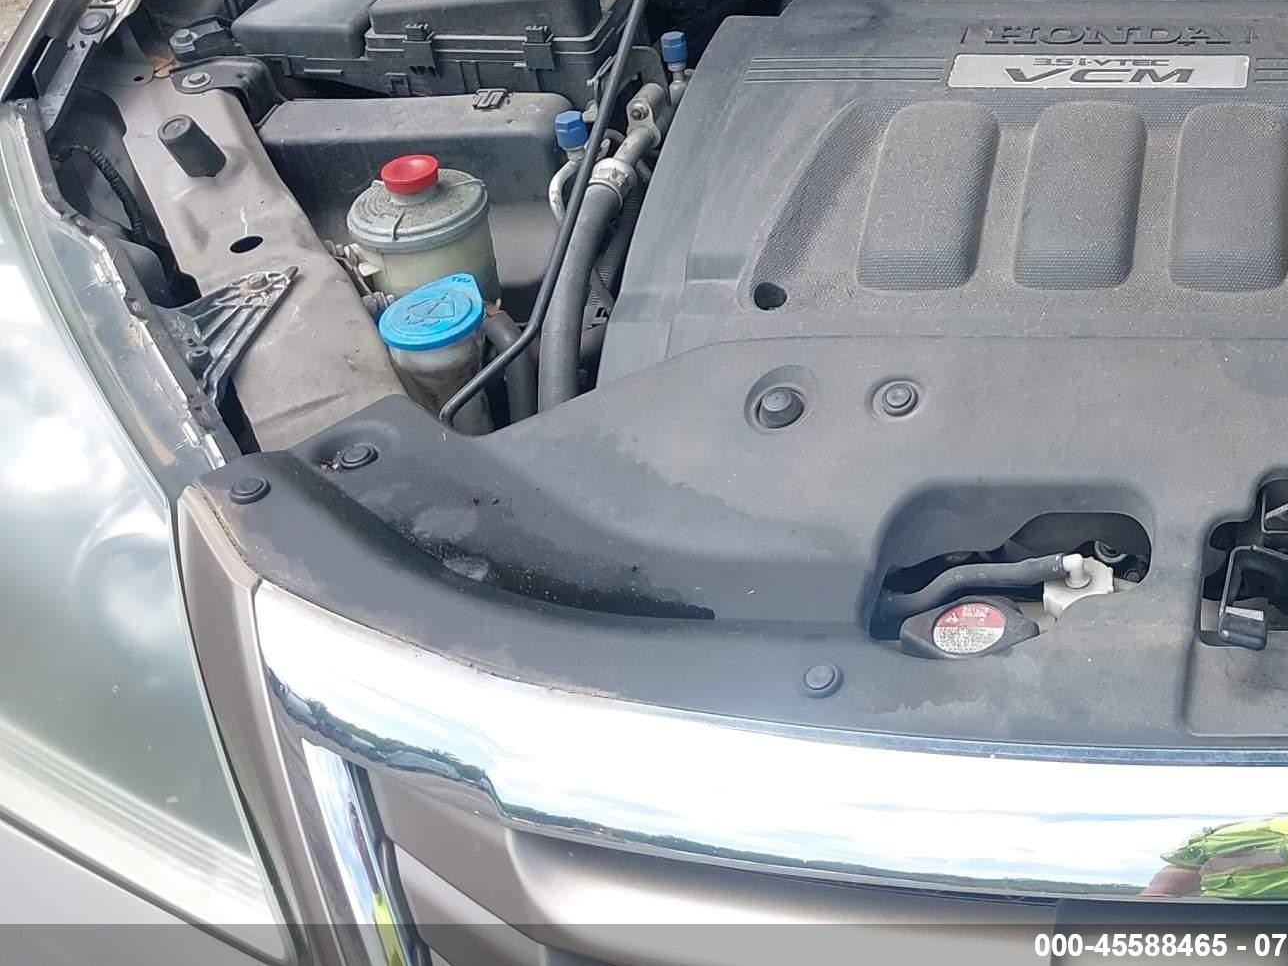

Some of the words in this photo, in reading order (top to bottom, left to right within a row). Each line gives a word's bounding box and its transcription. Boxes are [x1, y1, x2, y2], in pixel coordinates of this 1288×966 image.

[985, 26, 1231, 45] HONDA
[1078, 58, 1170, 66] i-VTEC
[1004, 68, 1195, 84] VCM
